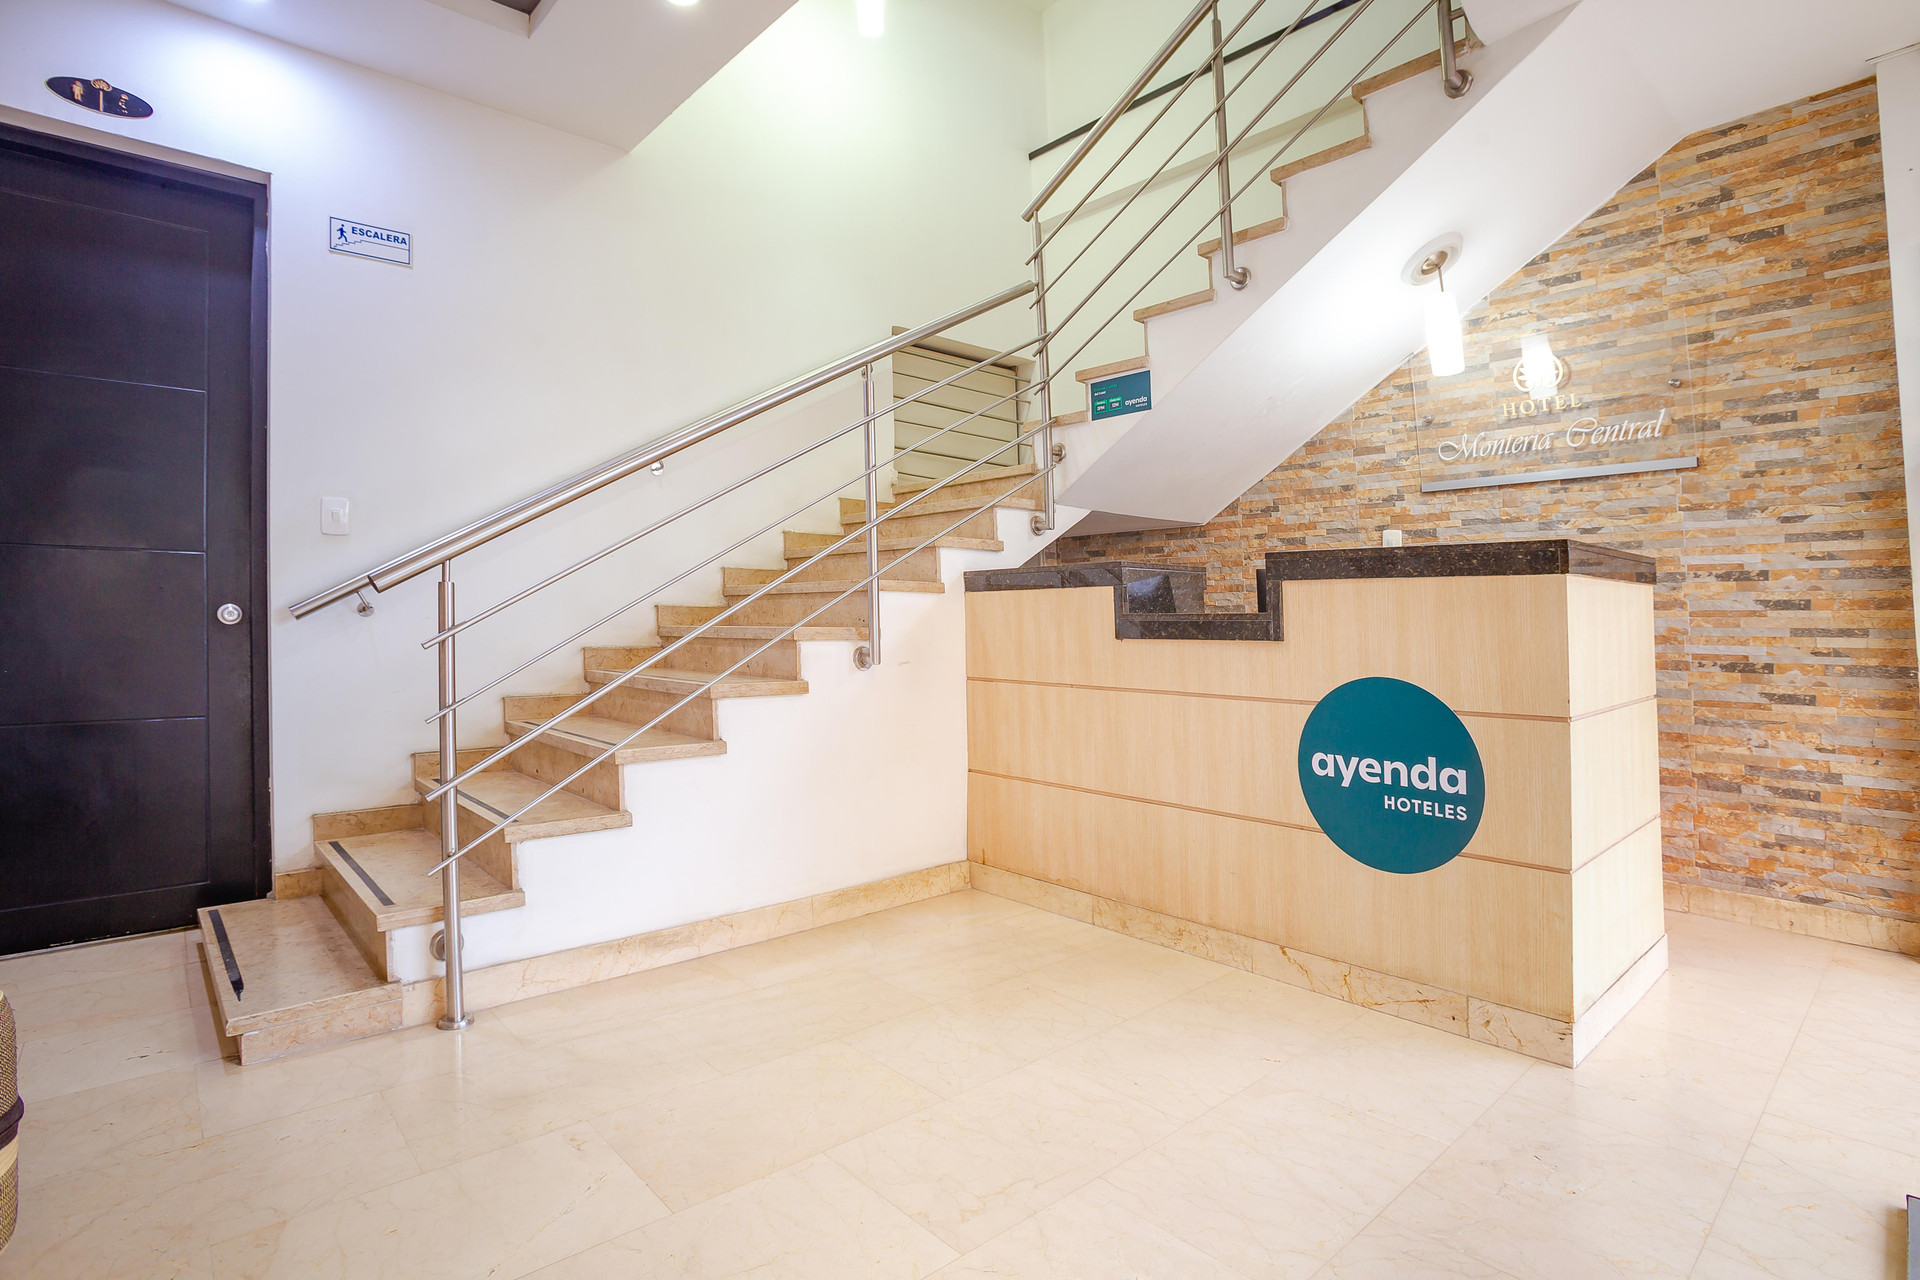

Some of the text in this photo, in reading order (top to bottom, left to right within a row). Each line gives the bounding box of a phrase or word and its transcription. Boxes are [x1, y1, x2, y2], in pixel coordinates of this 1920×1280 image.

[351, 226, 407, 245] ESCALERA
[1125, 396, 1147, 406] ayenda
[1502, 393, 1582, 417] HOTEL
[1566, 408, 1666, 448] Central
[1311, 752, 1468, 795] ayenda
[1384, 795, 1468, 821] HOTELES
